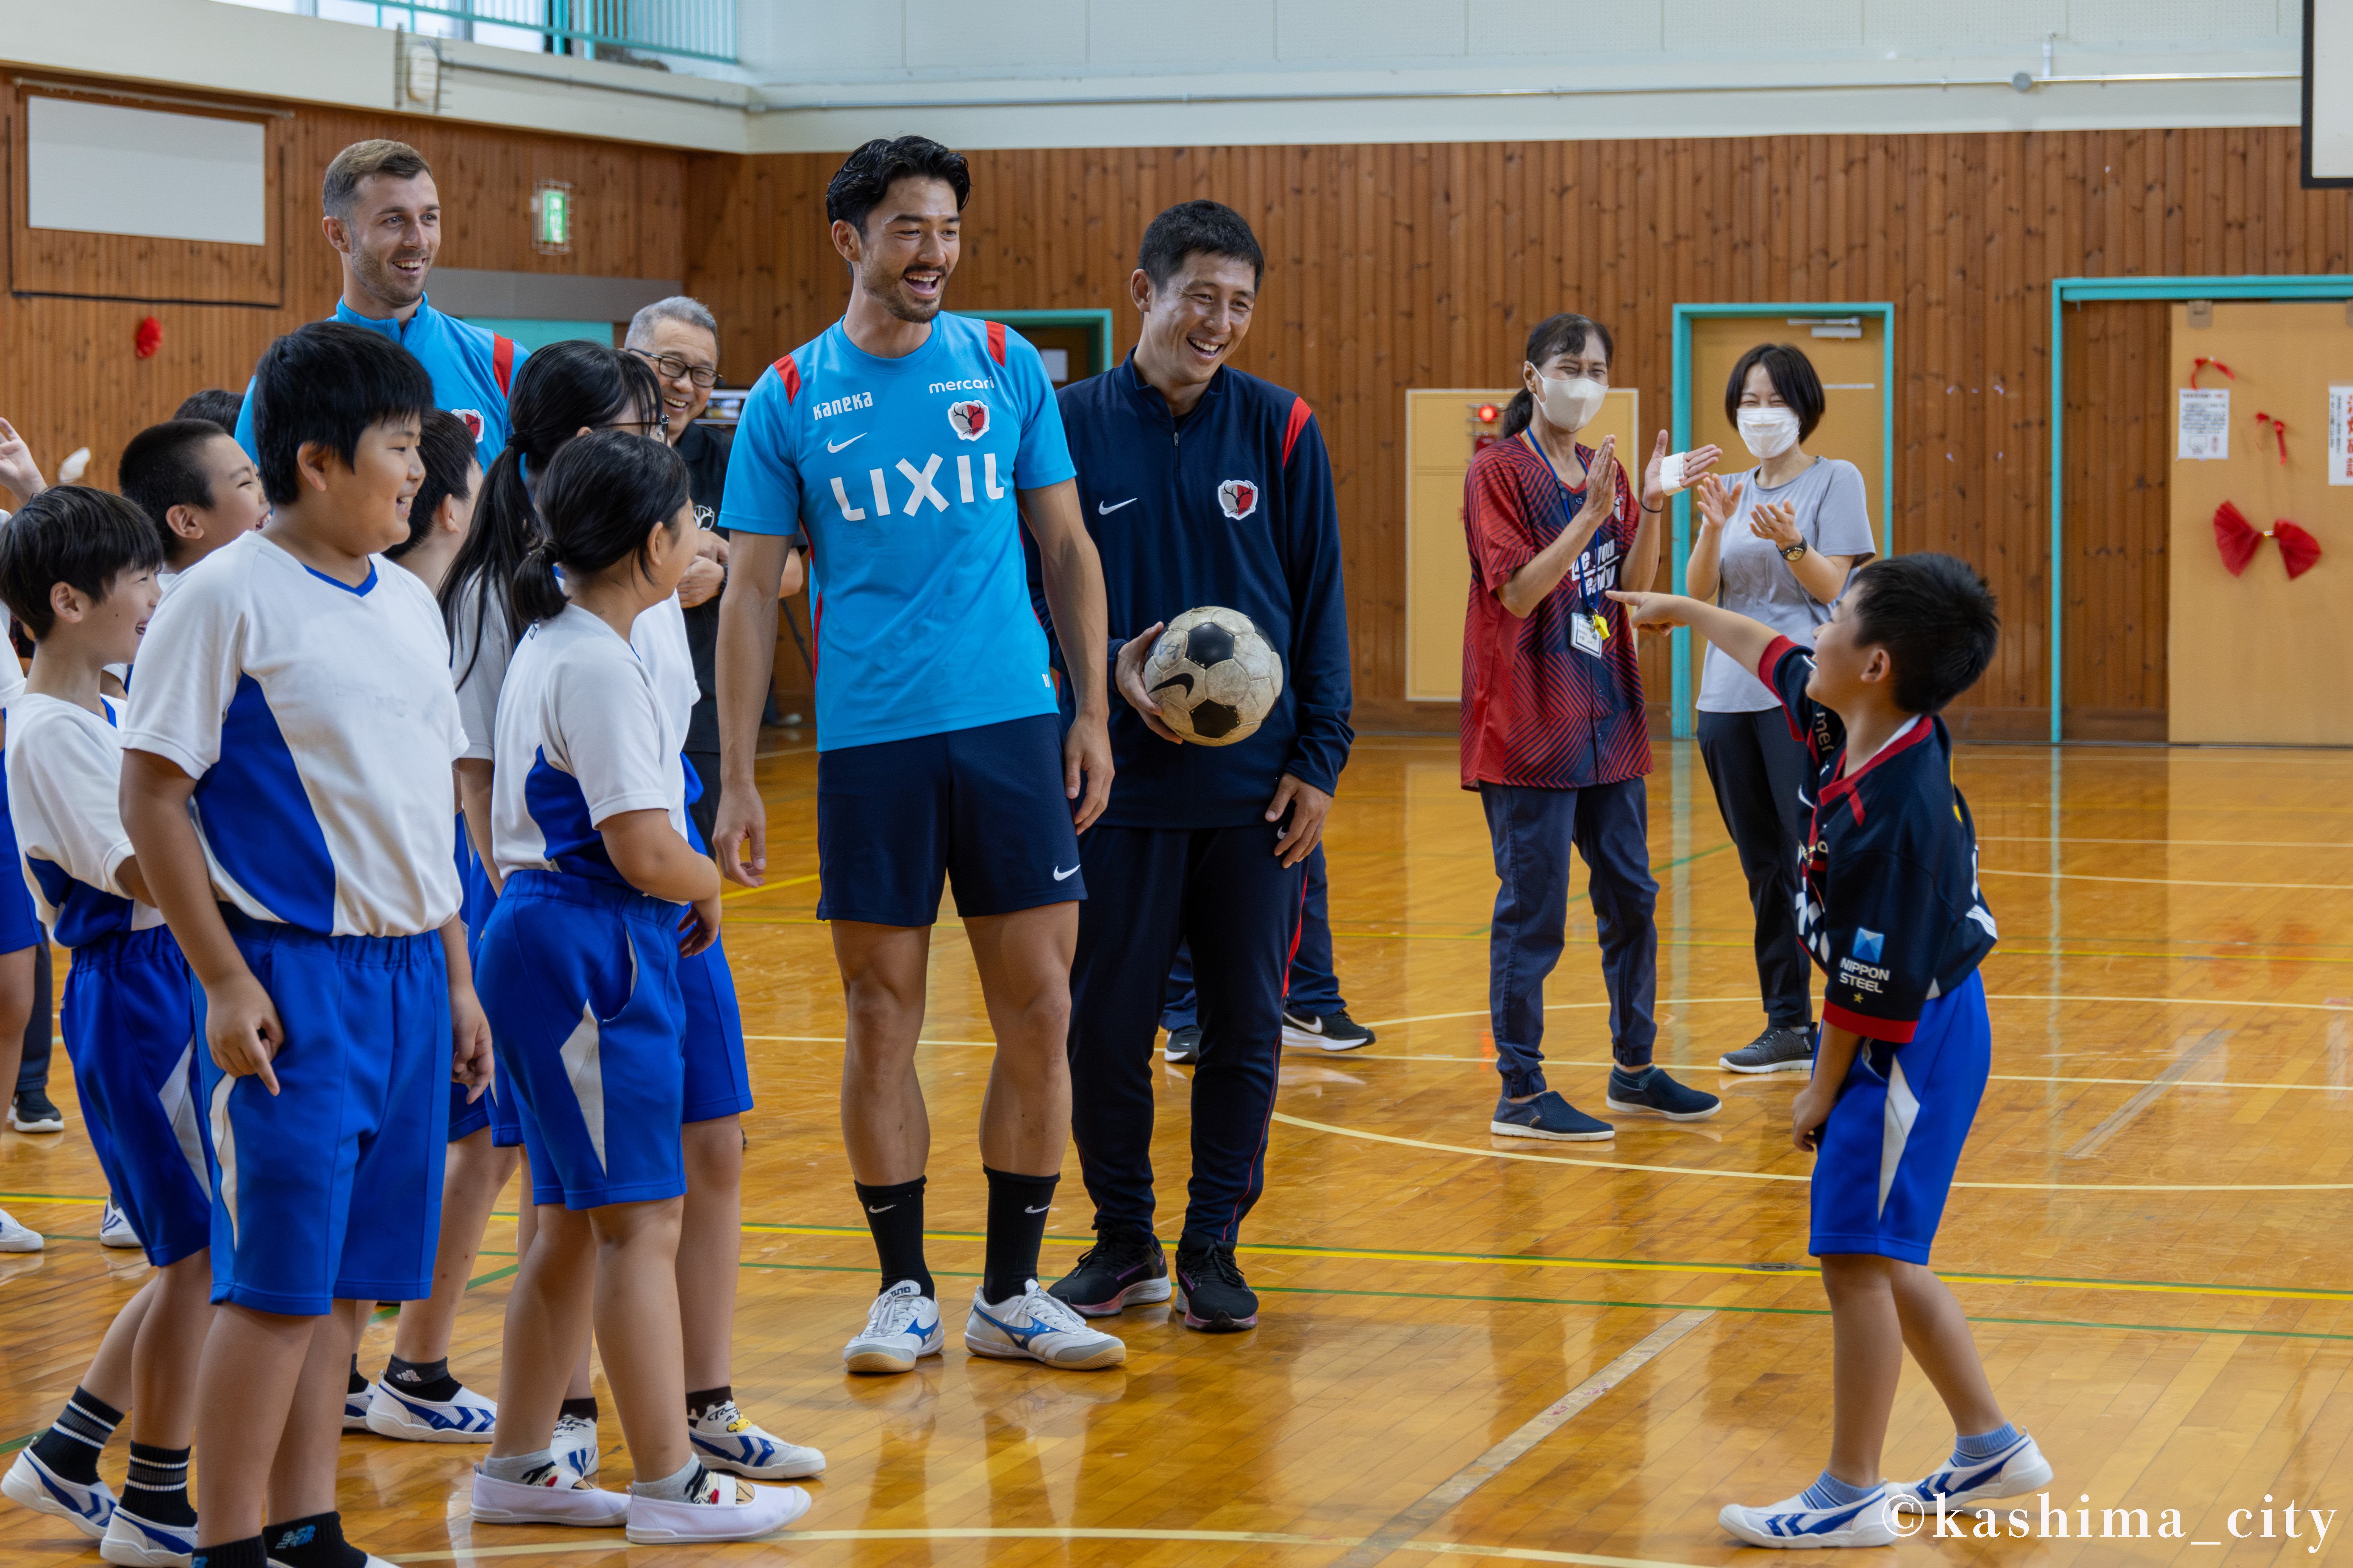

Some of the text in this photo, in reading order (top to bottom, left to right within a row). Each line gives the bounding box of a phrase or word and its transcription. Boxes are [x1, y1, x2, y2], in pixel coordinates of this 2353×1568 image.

[928, 376, 995, 394] mercari
[830, 453, 1005, 521] LIXIL
[1839, 957, 1890, 981] NIPPON
[1839, 972, 1883, 994] STEEL
